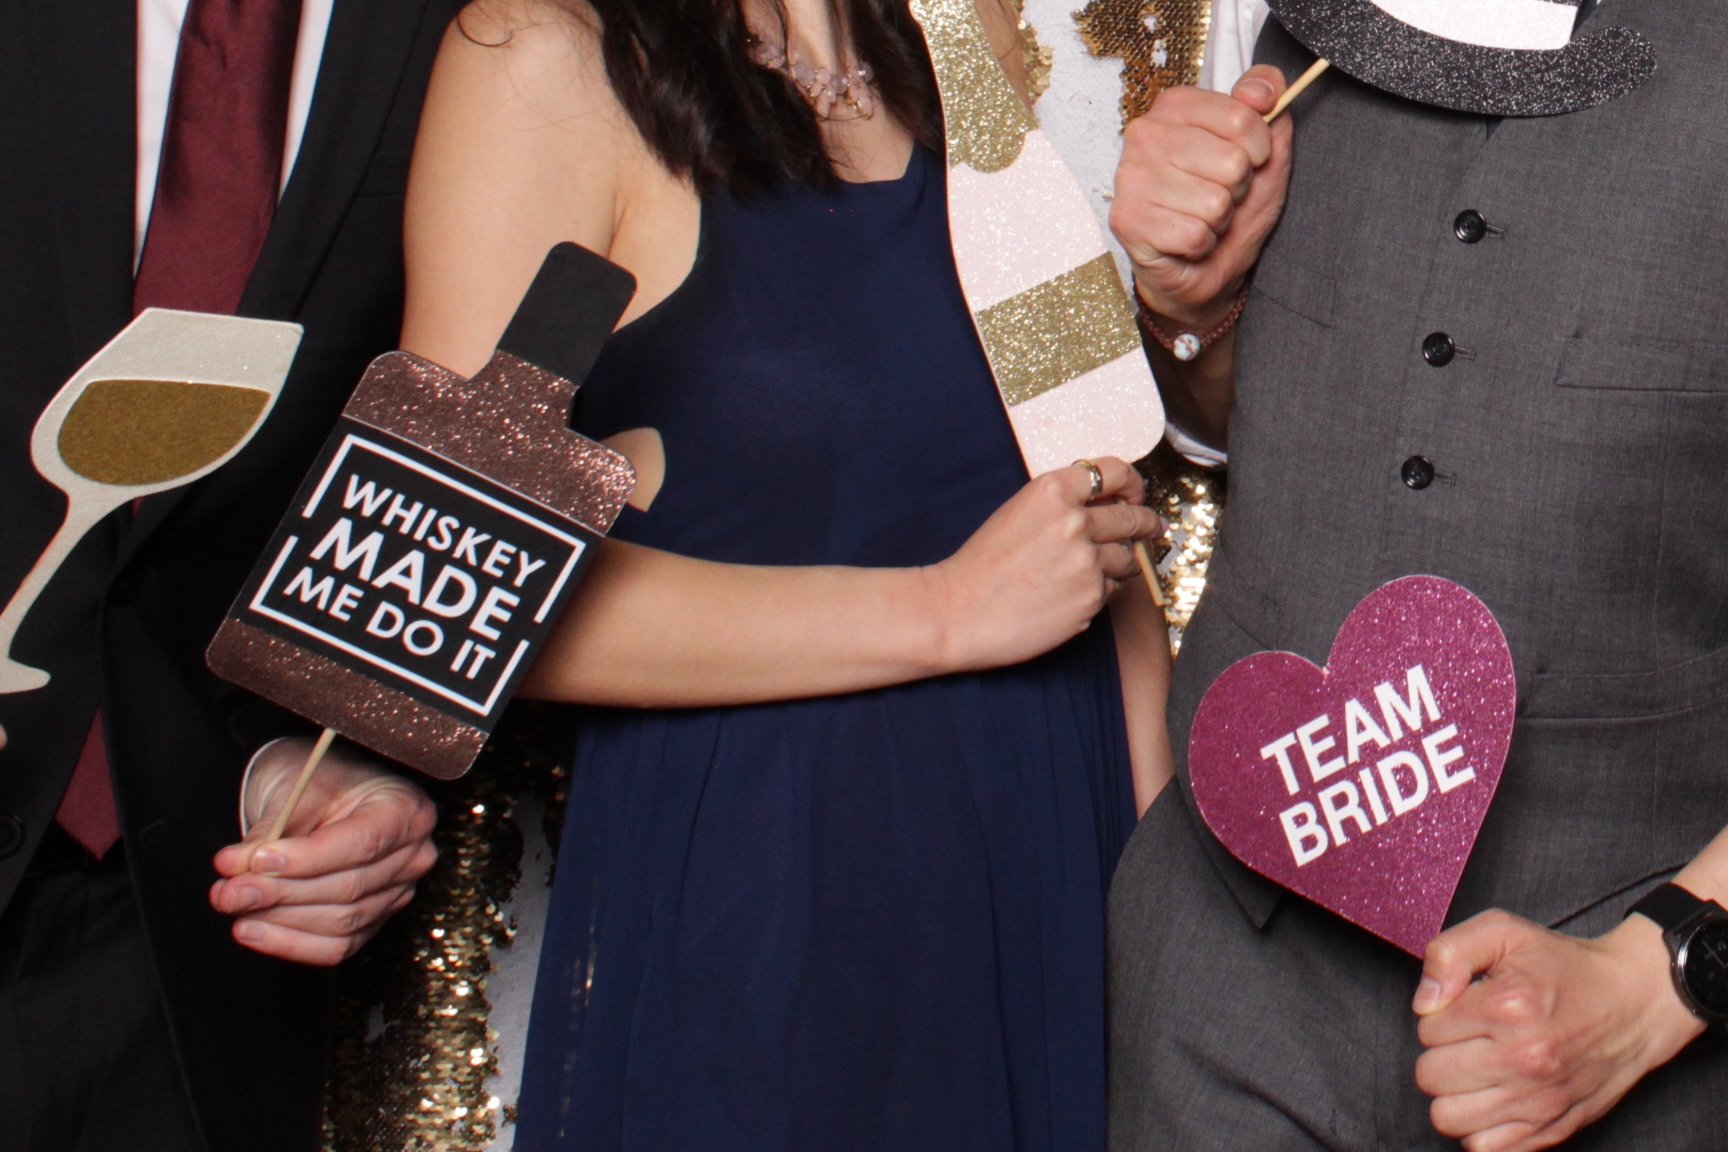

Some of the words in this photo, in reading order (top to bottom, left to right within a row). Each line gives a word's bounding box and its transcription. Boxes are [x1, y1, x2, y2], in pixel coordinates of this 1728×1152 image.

[309, 516, 521, 642] MADE
[342, 473, 547, 589] WHISKEY
[283, 565, 365, 622] ME
[365, 600, 445, 657] DO
[449, 638, 497, 680] IT
[1259, 663, 1442, 797] TEAM
[1278, 722, 1477, 868] BRIDE
